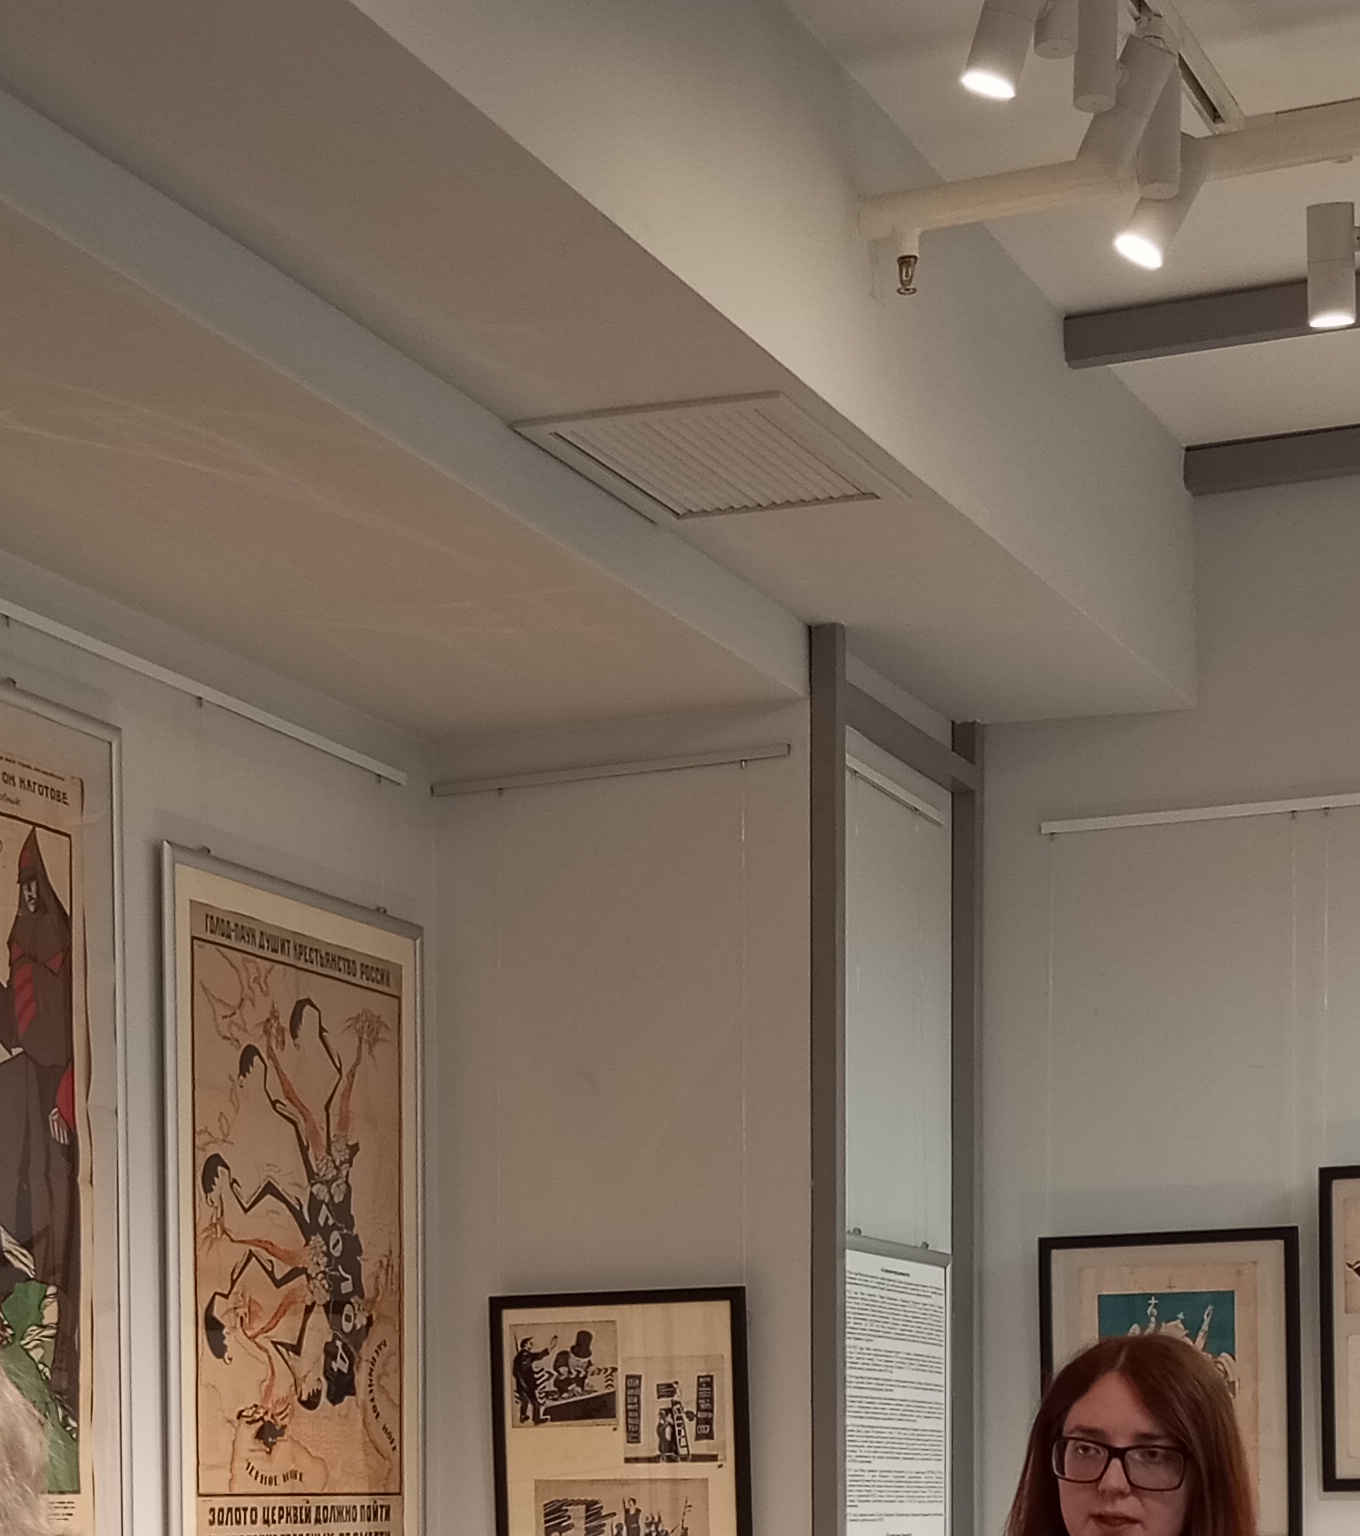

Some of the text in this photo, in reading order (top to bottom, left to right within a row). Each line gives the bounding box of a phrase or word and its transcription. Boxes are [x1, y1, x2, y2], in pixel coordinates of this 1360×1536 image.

[1, 771, 16, 788] ОН
[204, 912, 391, 988] ГОЛОД-ПАУК ДУШИТ КРЕСТЬЯНСТВО РОССИИ
[208, 1499, 391, 1527] ЗОЛОТО ЦЕРКВЕЙ ДОЛЖНО ПОЙТИ
